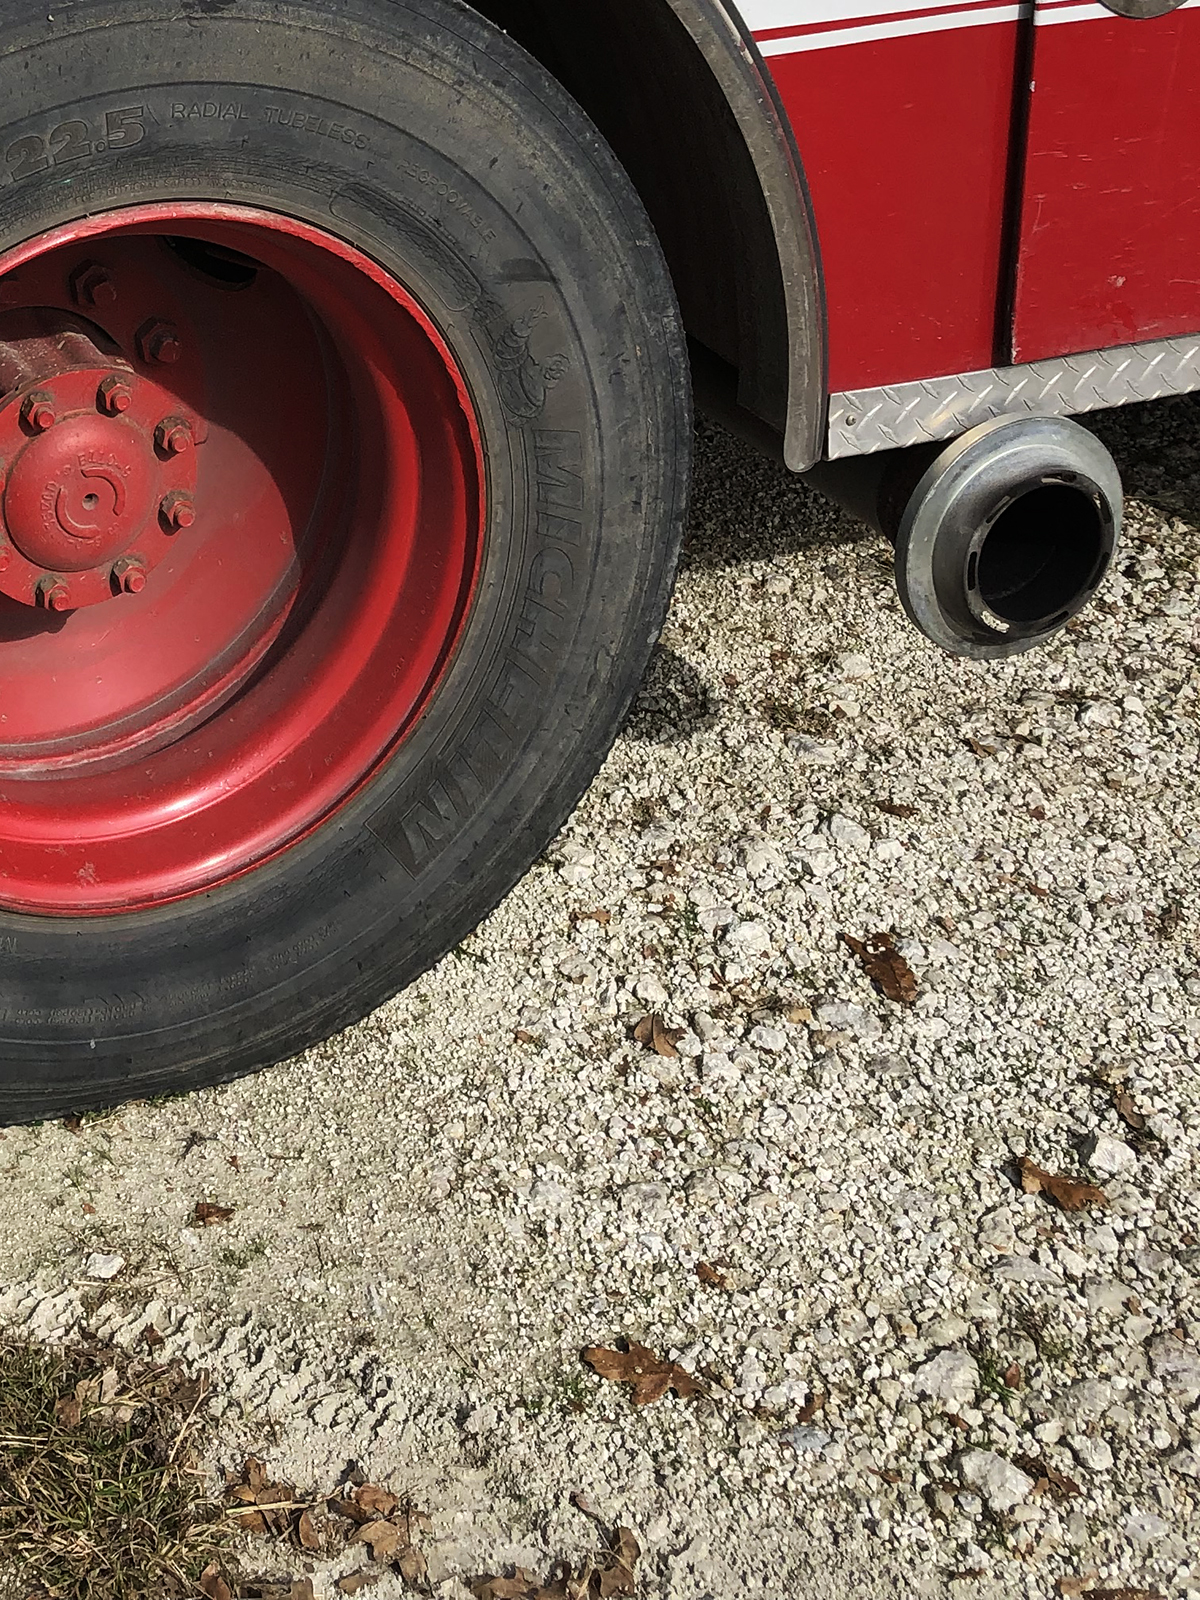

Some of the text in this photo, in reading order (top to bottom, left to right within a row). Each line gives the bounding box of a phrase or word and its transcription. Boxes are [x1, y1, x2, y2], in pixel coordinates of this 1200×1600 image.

[170, 101, 250, 122] RADIAL
[266, 106, 370, 151] TUBELESS
[401, 428, 584, 865] MICHELIN
